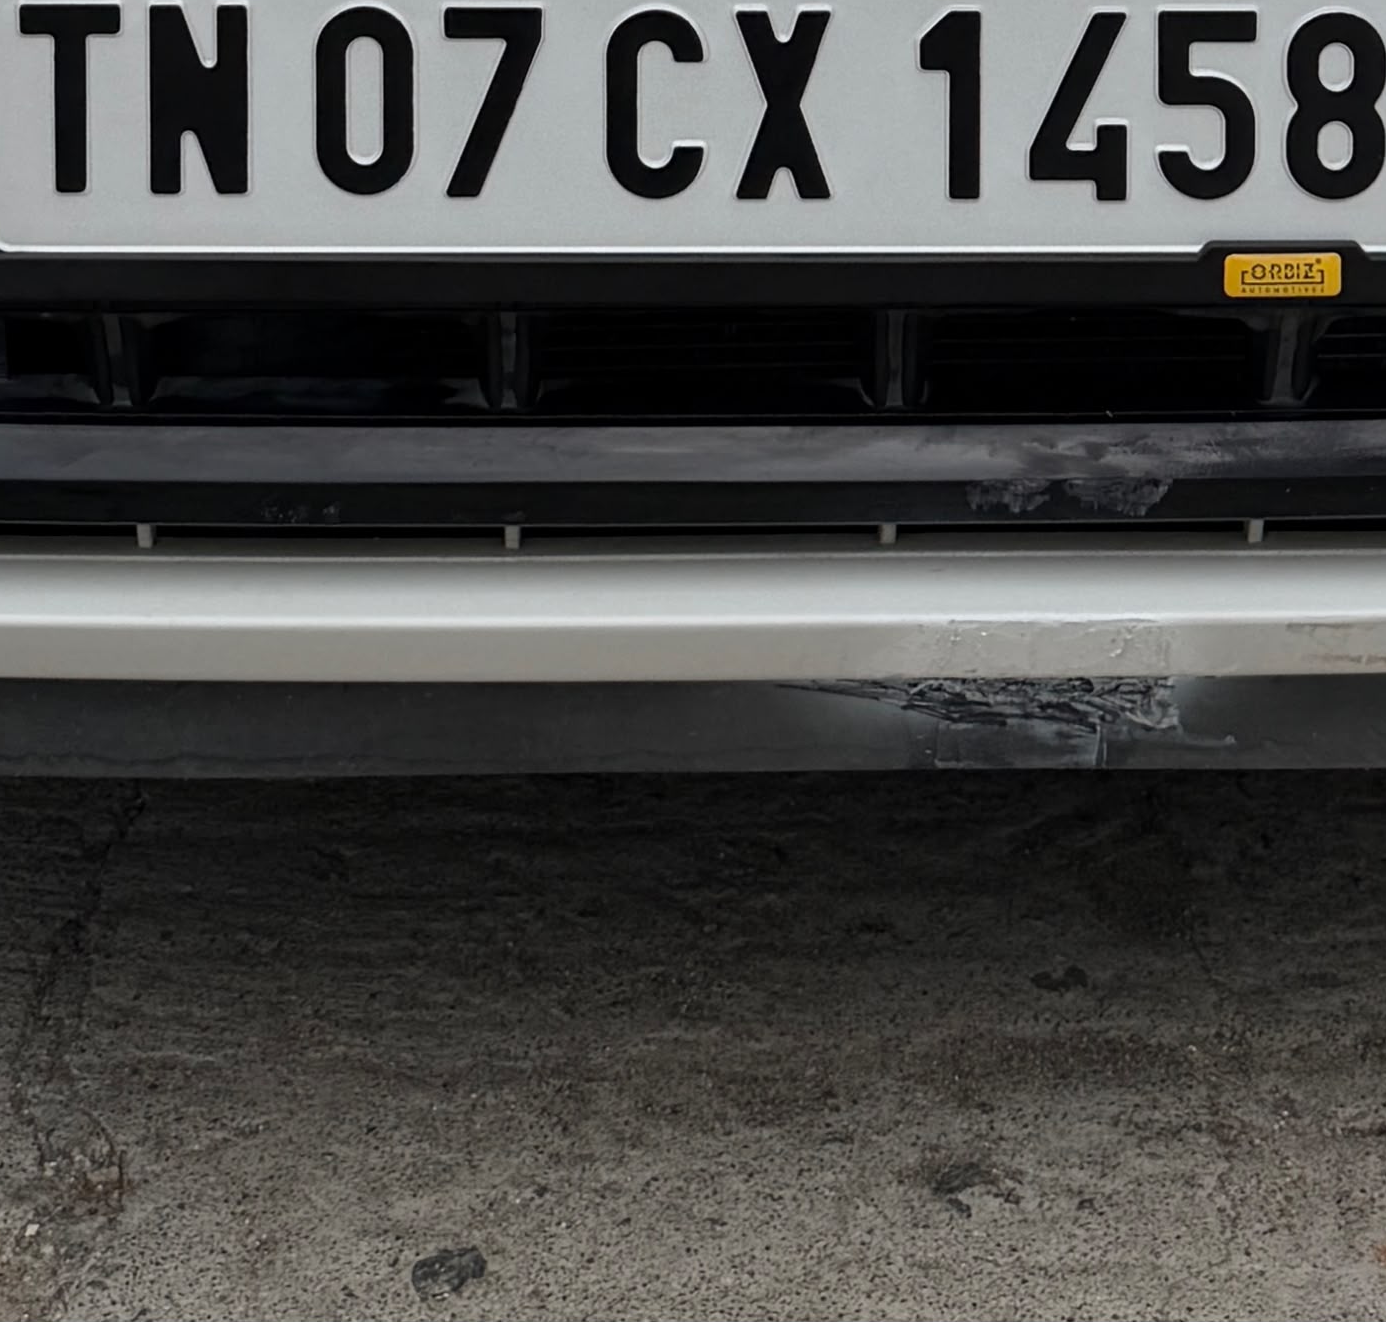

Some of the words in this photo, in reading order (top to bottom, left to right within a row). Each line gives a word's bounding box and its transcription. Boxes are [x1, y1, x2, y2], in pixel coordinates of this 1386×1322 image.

[17, 2, 250, 197] TN
[313, 5, 544, 199] 07
[604, 8, 833, 202] CX
[1251, 263, 1316, 280] ORBIZ
